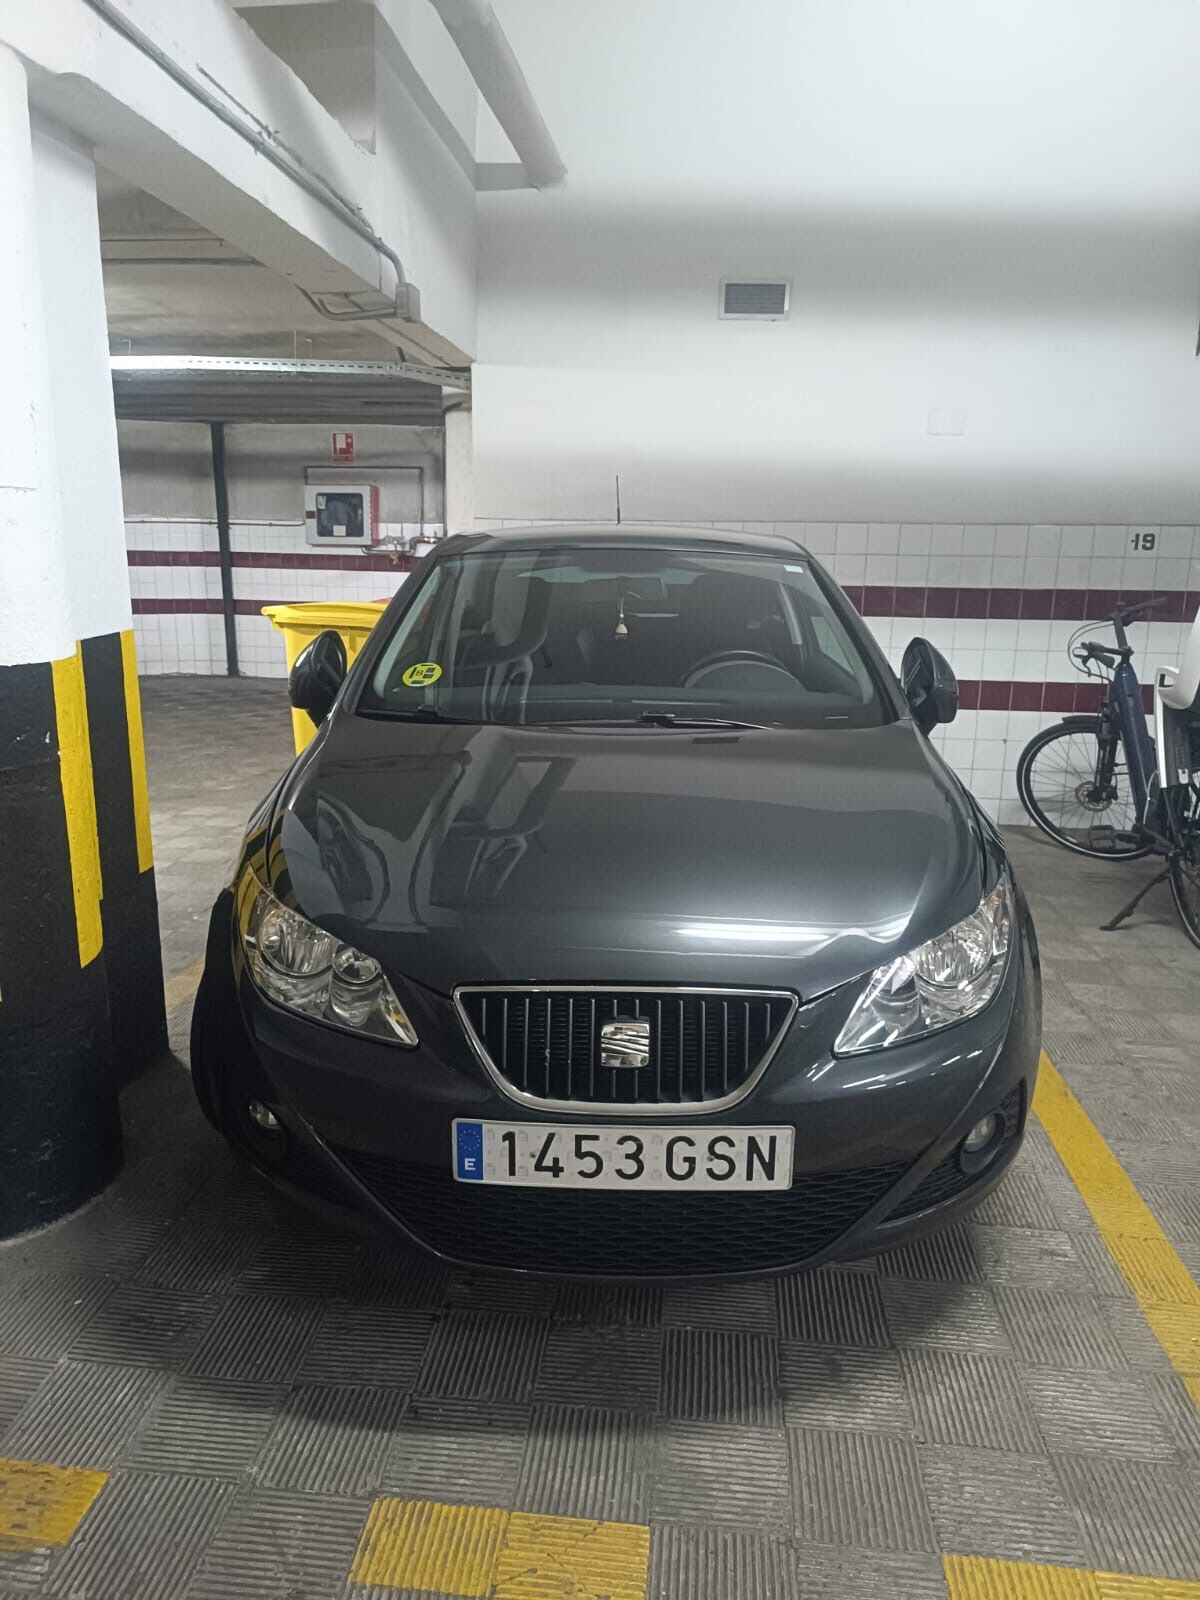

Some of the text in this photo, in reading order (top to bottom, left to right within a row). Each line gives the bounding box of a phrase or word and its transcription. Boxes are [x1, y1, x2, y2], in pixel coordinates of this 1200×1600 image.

[1134, 533, 1155, 550] 19
[464, 1158, 476, 1171] E
[501, 1131, 777, 1181] 1453 GSN
